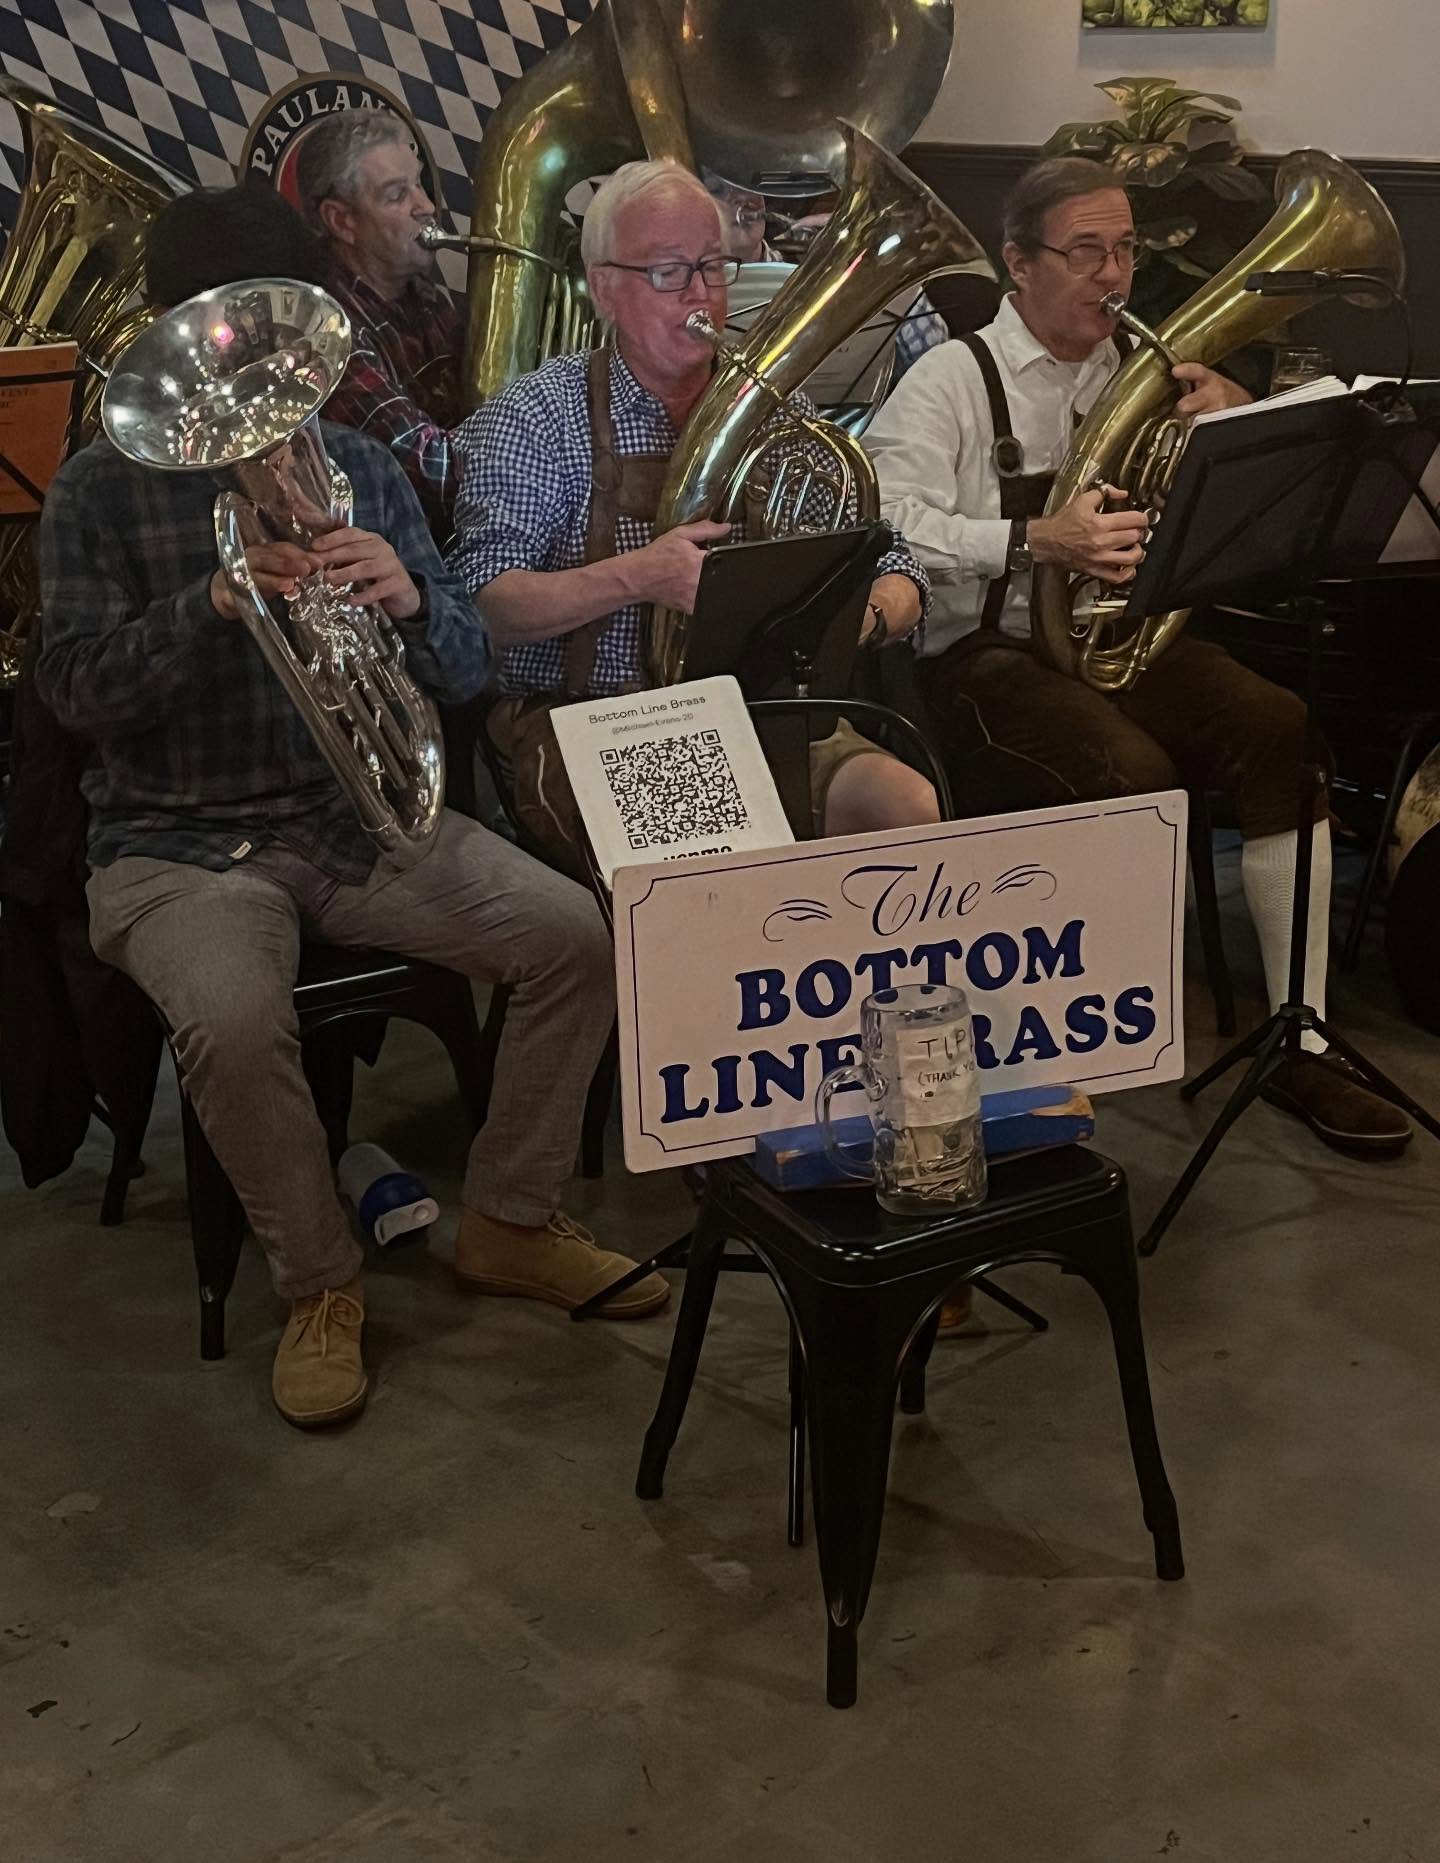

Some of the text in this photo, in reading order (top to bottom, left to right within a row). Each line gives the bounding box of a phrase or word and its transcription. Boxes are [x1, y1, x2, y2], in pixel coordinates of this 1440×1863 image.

[252, 86, 420, 176] PAULAN
[588, 696, 706, 724] Bottom Line Brass
[841, 862, 981, 936] The
[735, 919, 1086, 1031] BOTTOM
[659, 985, 1156, 1124] LINE ASS
